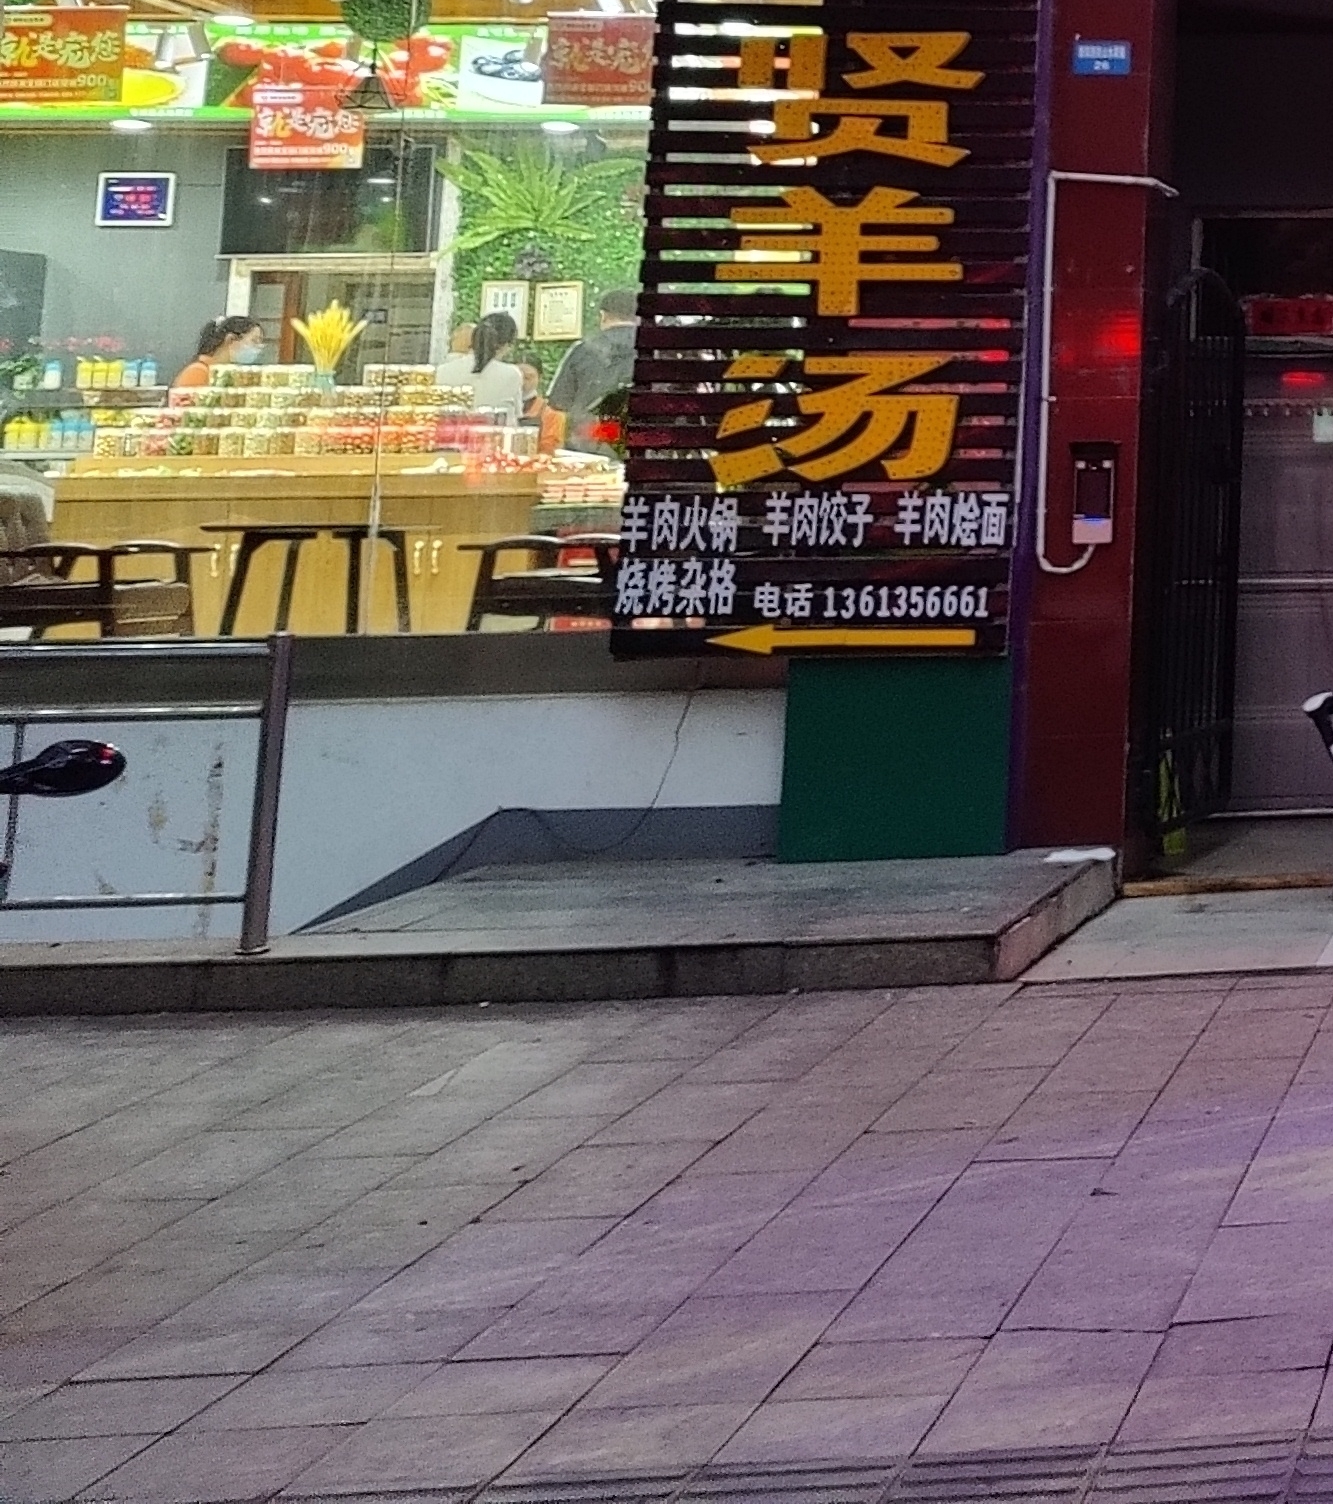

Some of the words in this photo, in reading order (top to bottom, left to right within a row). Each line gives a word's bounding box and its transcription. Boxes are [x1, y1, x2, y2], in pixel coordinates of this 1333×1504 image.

[619, 495, 739, 552] 羊肉火锅
[762, 492, 873, 548] 羊肉饺子
[894, 489, 1009, 546] 羊肉烩面
[614, 558, 737, 616] 烧烤杂格
[753, 582, 813, 618] 电话
[823, 586, 989, 619] 1361356661
